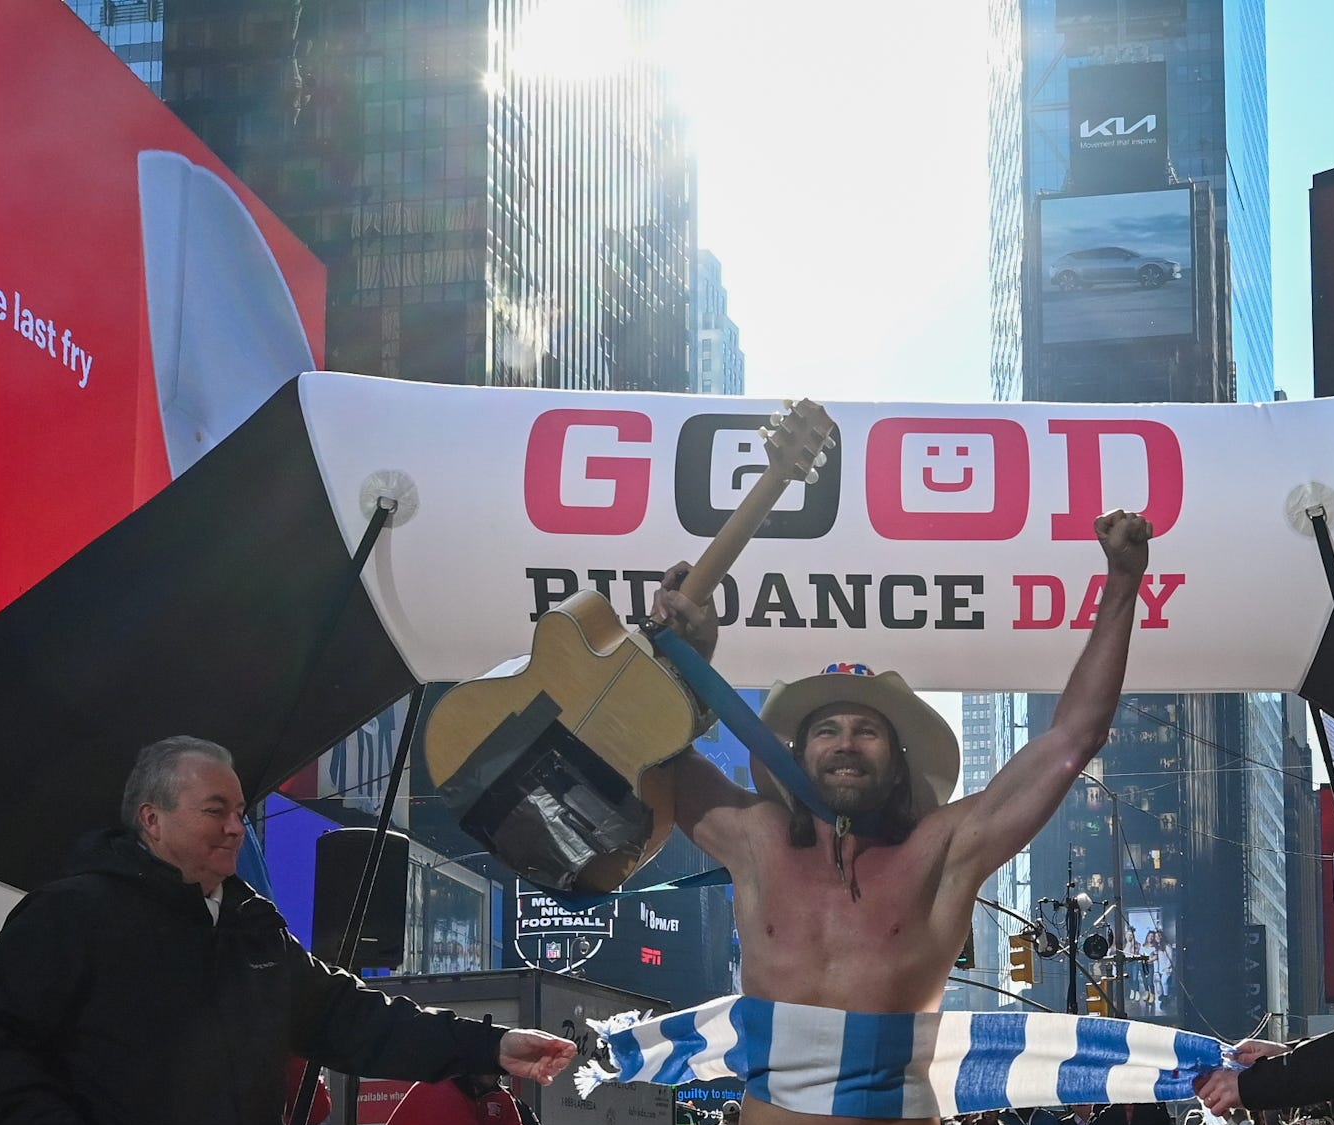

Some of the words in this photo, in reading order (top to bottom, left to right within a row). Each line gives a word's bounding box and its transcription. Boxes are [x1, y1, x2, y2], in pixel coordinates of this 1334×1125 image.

[1080, 139, 1115, 150] Movement
[1117, 138, 1130, 146] that
[13, 291, 57, 358] last
[62, 328, 94, 389] fry
[522, 407, 1185, 543] GOOD
[1013, 573, 1186, 631] DAY
[521, 917, 605, 928] FOOTBALL
[678, 1088, 709, 1101] guilty
[711, 1089, 720, 1099] to
